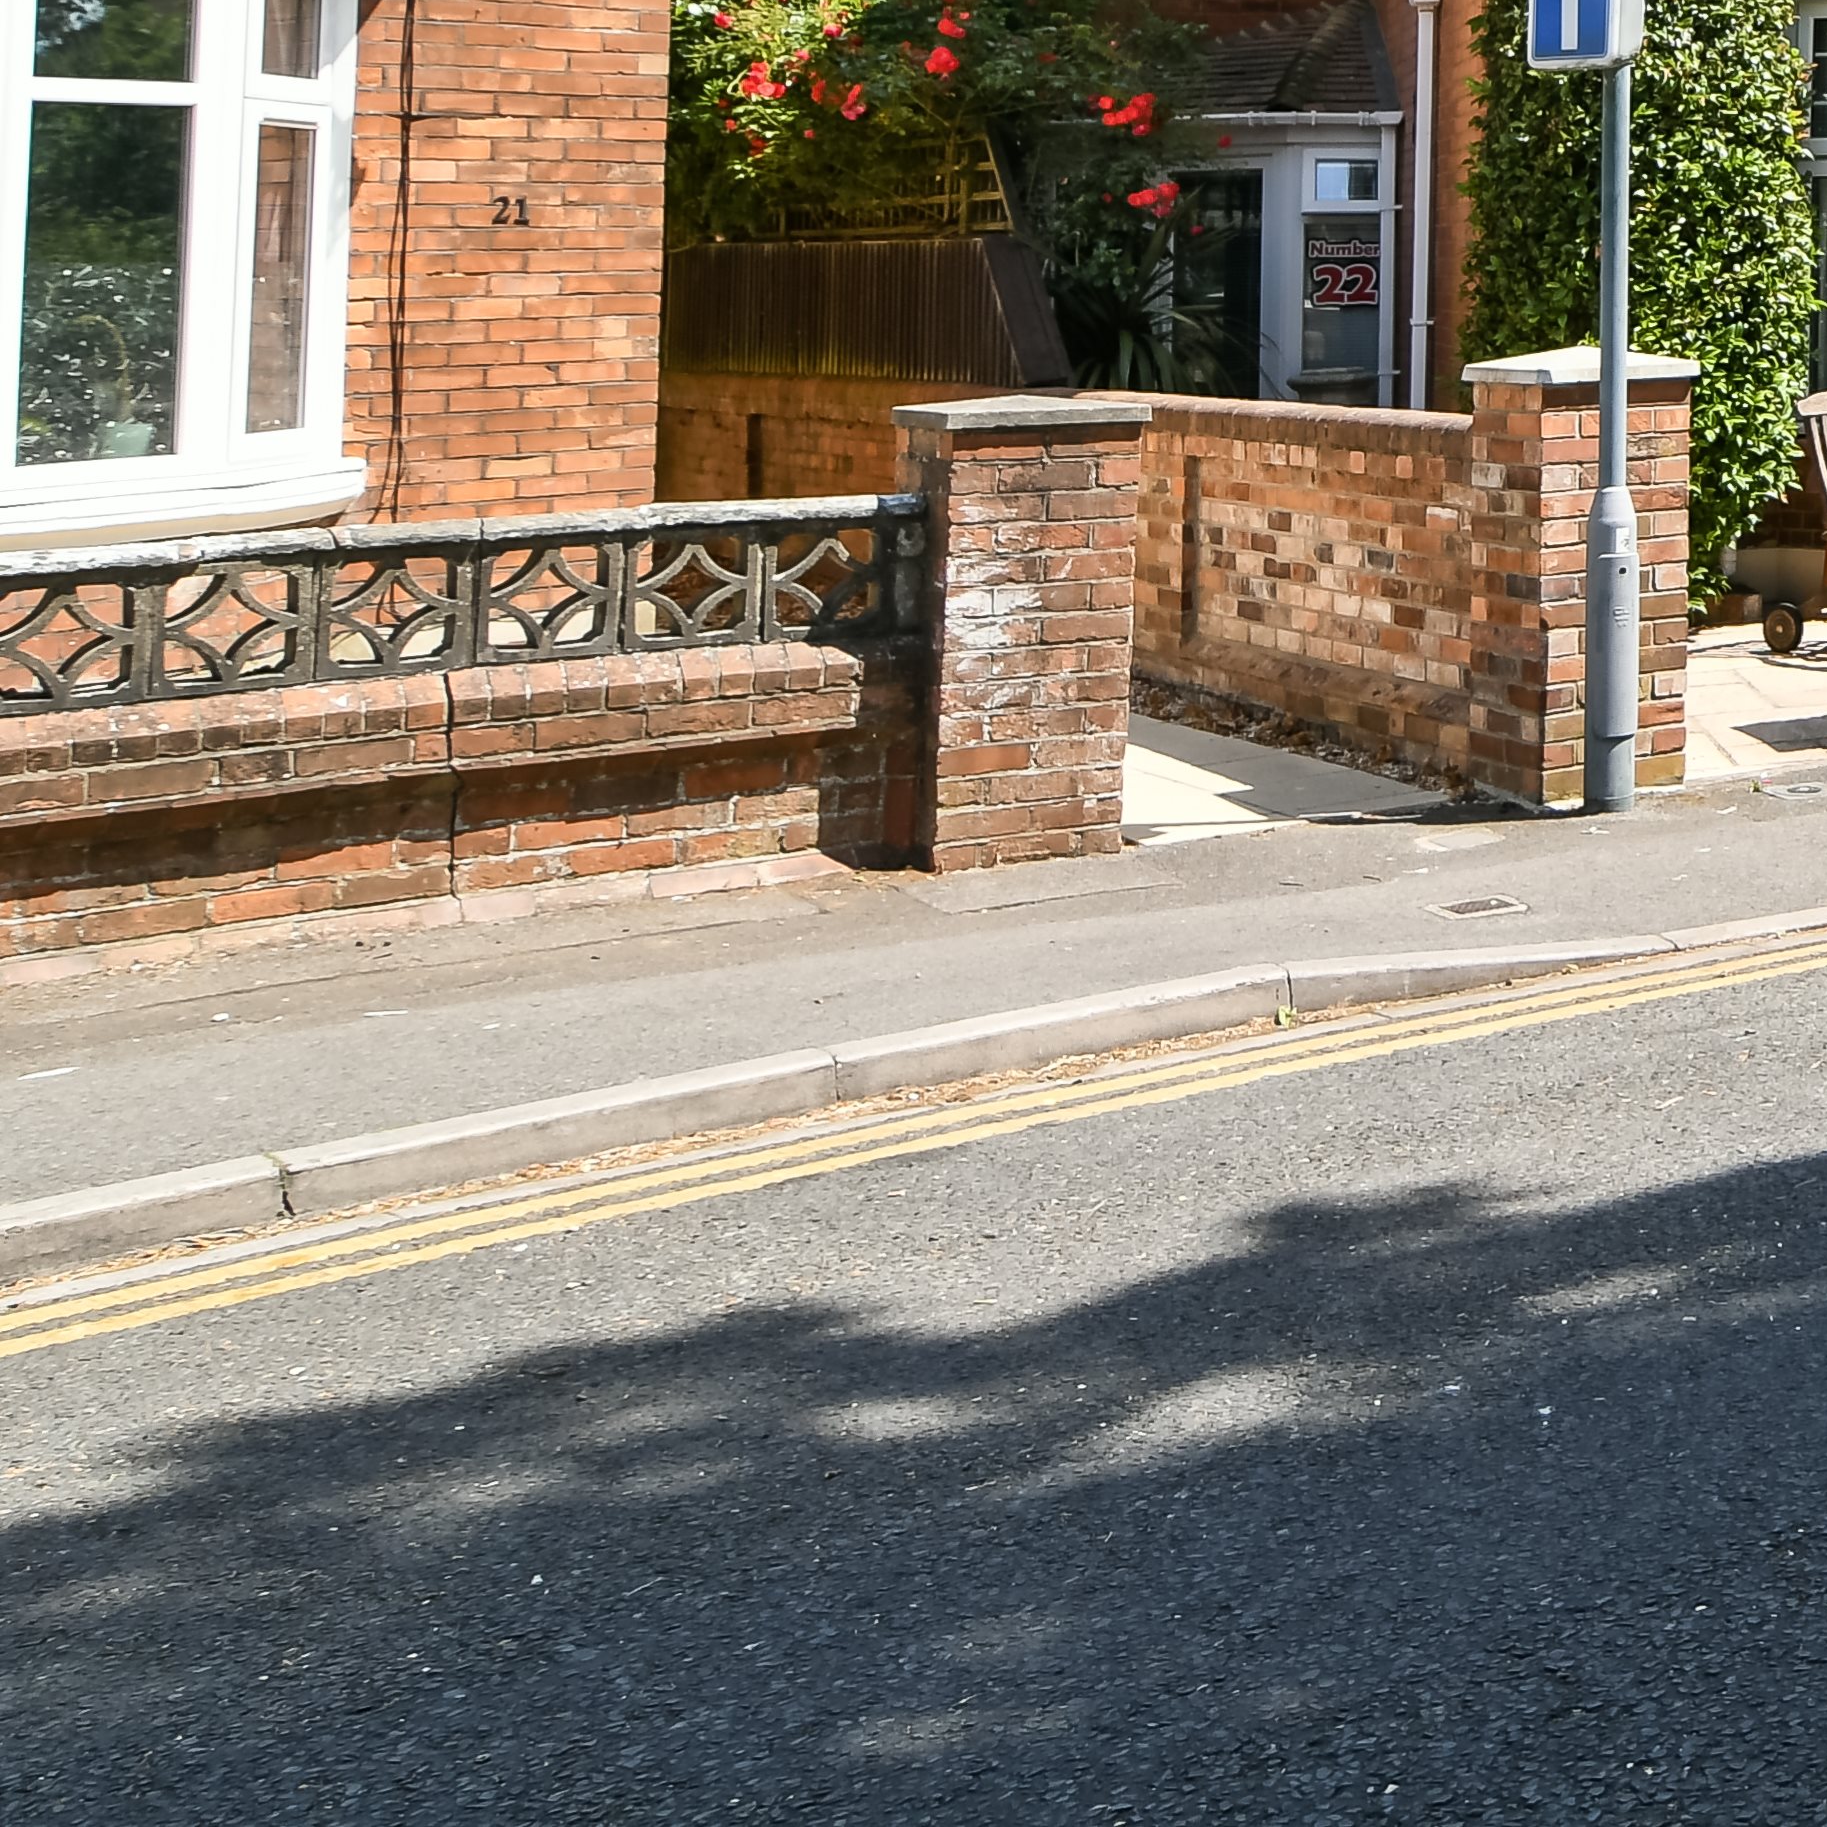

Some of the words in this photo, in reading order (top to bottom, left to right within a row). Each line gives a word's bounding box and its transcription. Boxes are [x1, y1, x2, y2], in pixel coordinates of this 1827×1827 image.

[491, 195, 530, 225] 21
[1308, 240, 1380, 258] Number
[1313, 263, 1378, 305] 22
